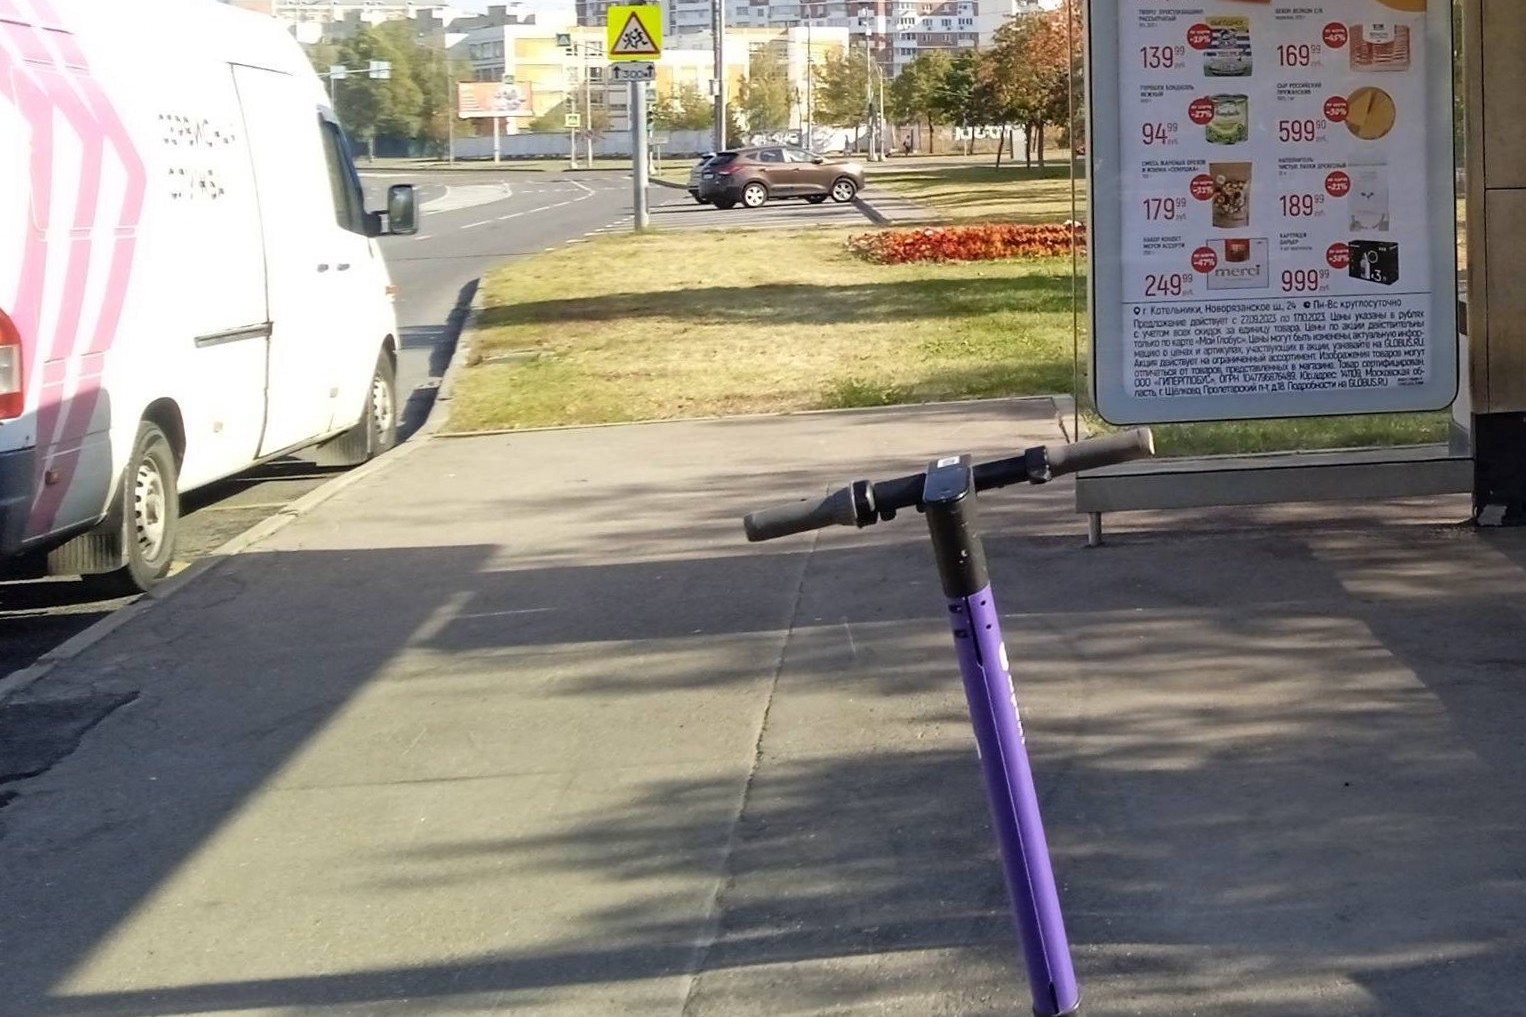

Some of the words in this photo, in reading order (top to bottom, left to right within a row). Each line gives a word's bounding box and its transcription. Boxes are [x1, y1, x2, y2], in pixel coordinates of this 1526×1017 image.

[1140, 46, 1173, 69] 139
[1276, 44, 1310, 67] 169
[1142, 123, 1167, 145] 94
[1279, 120, 1315, 142] 599
[1143, 198, 1175, 220] 179
[1279, 194, 1313, 216] 189
[1215, 264, 1260, 277] merci
[1281, 269, 1318, 292] 999
[1145, 274, 1181, 297] 249
[1205, 303, 1270, 313] Новорязанское
[1313, 299, 1338, 309] Пн-Вс
[1340, 299, 1401, 310] круглосуточно
[1190, 317, 1227, 326] действует
[1331, 312, 1351, 321] Цены
[1355, 311, 1387, 321] указаны
[1398, 309, 1424, 320] рублях
[1270, 334, 1291, 343] могут
[1134, 378, 1151, 387] ООО
[1366, 367, 1410, 376] Московская
[1288, 380, 1336, 391] Подробности
